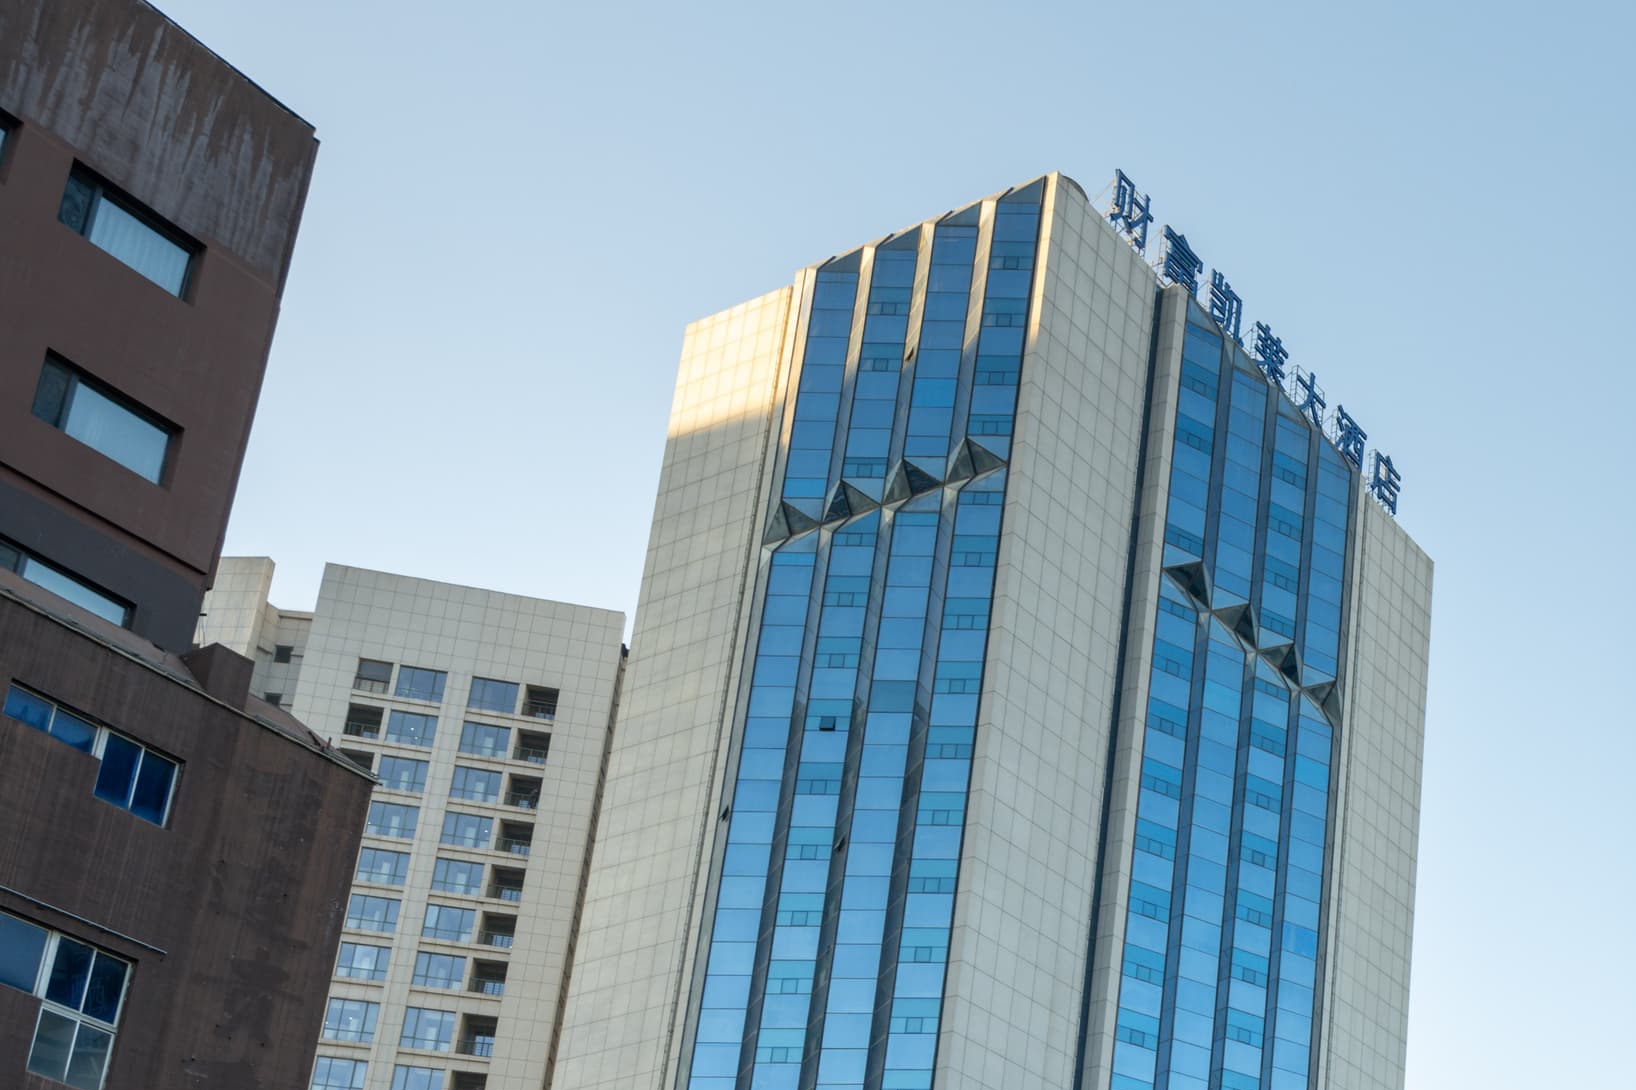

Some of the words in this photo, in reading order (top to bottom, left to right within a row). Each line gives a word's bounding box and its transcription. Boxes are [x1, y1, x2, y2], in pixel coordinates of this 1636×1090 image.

[1111, 168, 1401, 515] 财富凯莱大酒店
